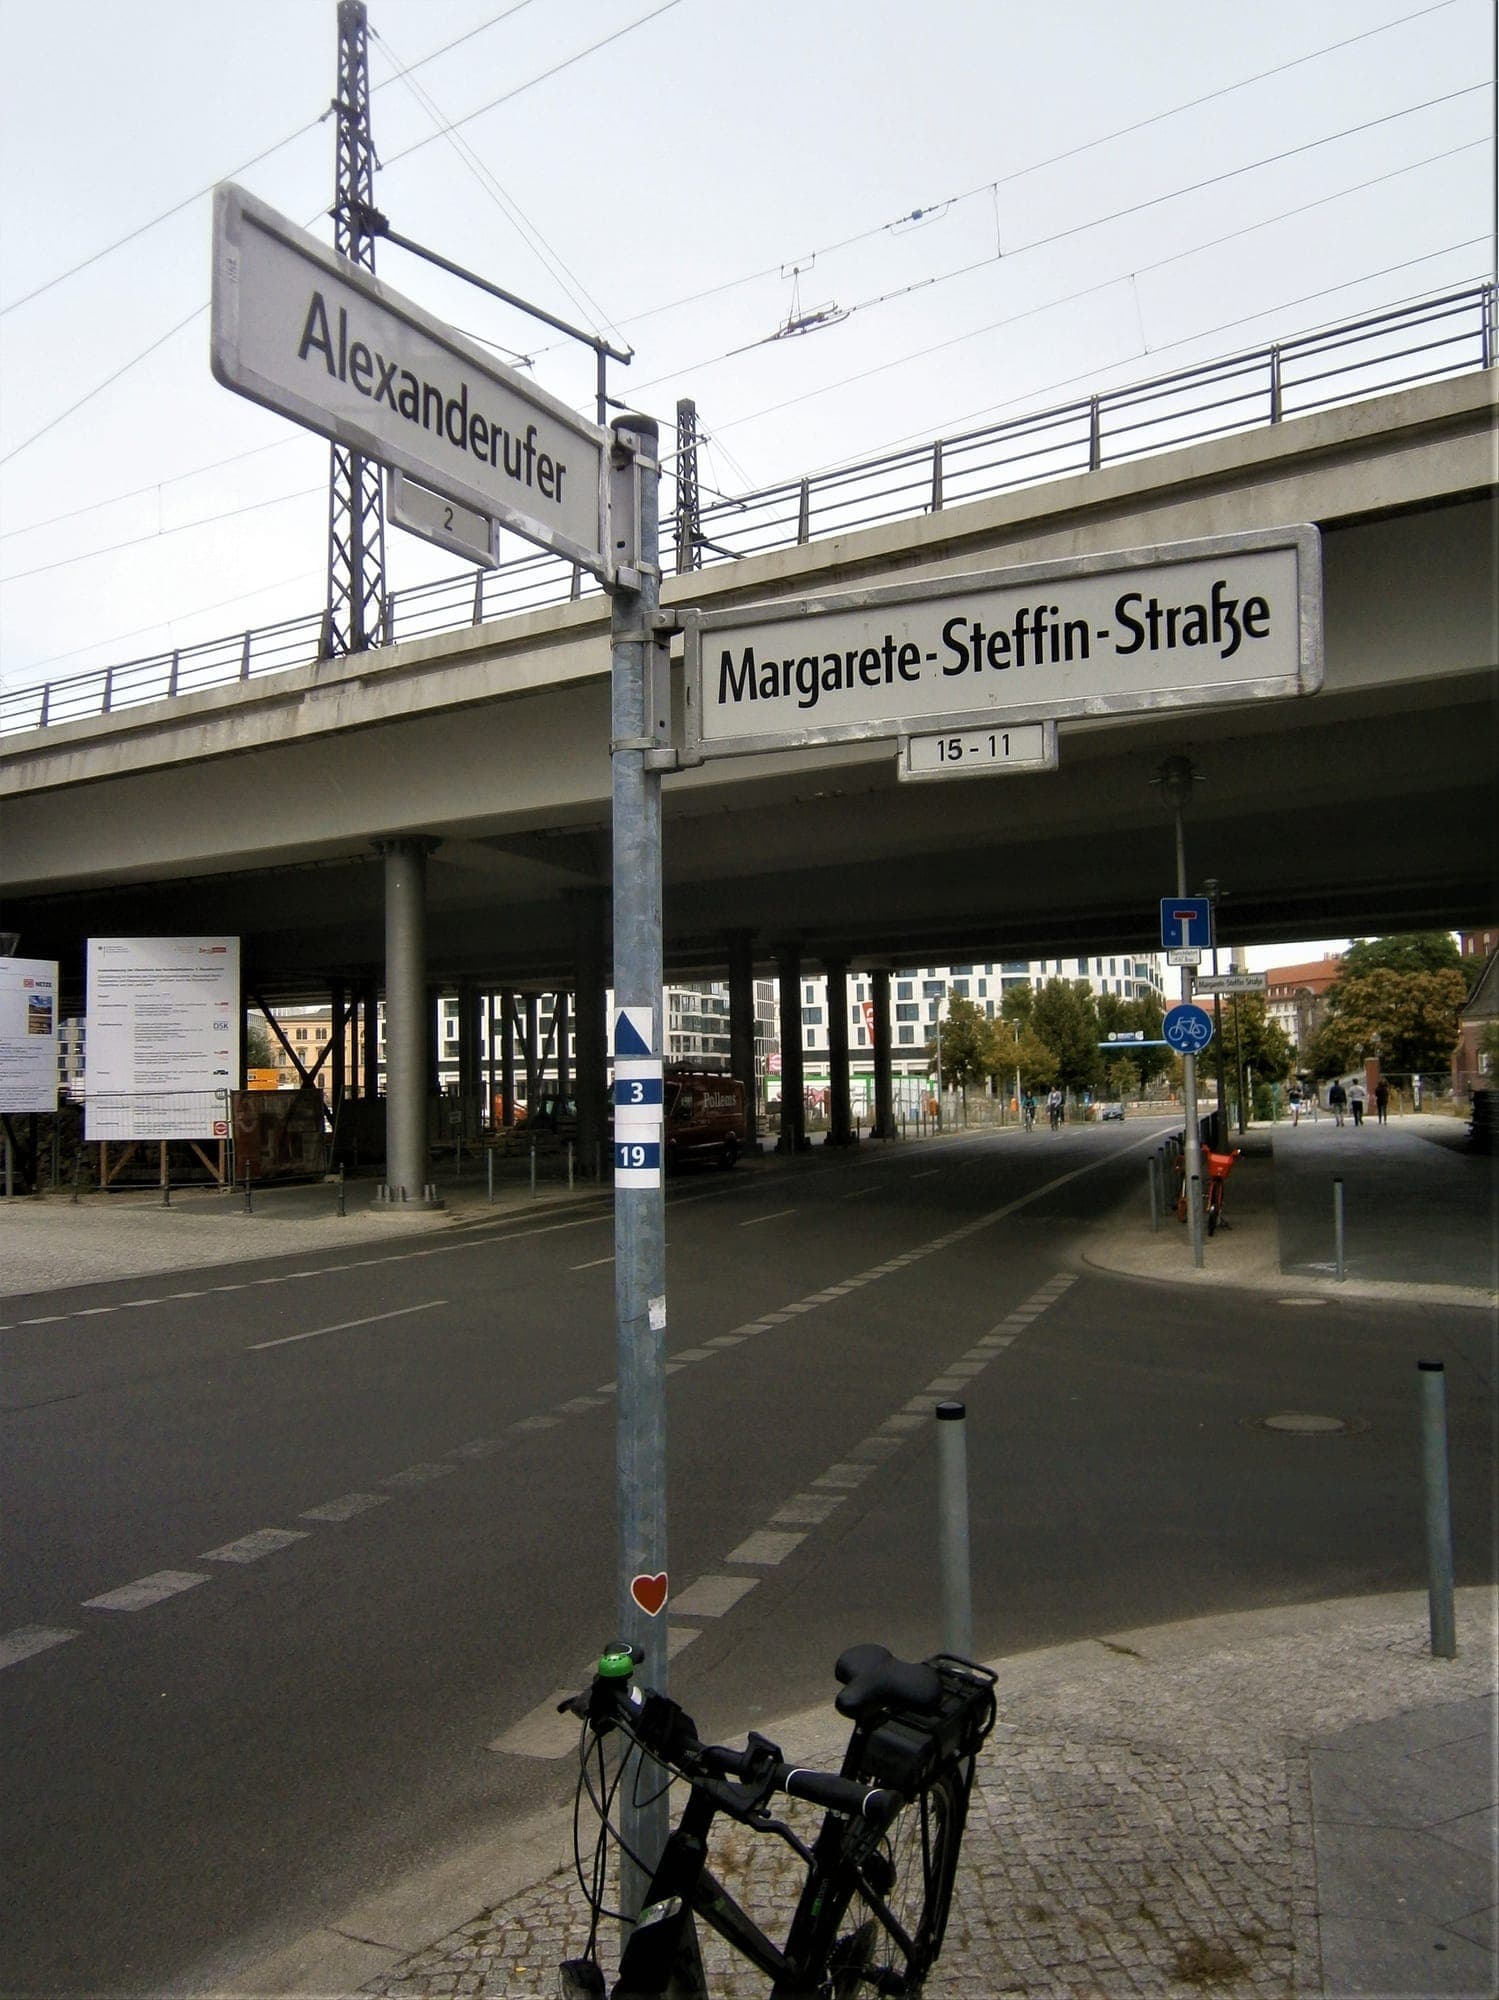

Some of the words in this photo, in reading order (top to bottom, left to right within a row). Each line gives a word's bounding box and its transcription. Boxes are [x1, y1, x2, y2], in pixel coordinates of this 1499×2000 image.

[298, 291, 567, 503] Alexanderufer
[443, 507, 454, 531] 2
[718, 581, 1270, 708] Margarete-Steffin-Straße
[630, 1082, 644, 1103] 3
[620, 1146, 645, 1167] 19
